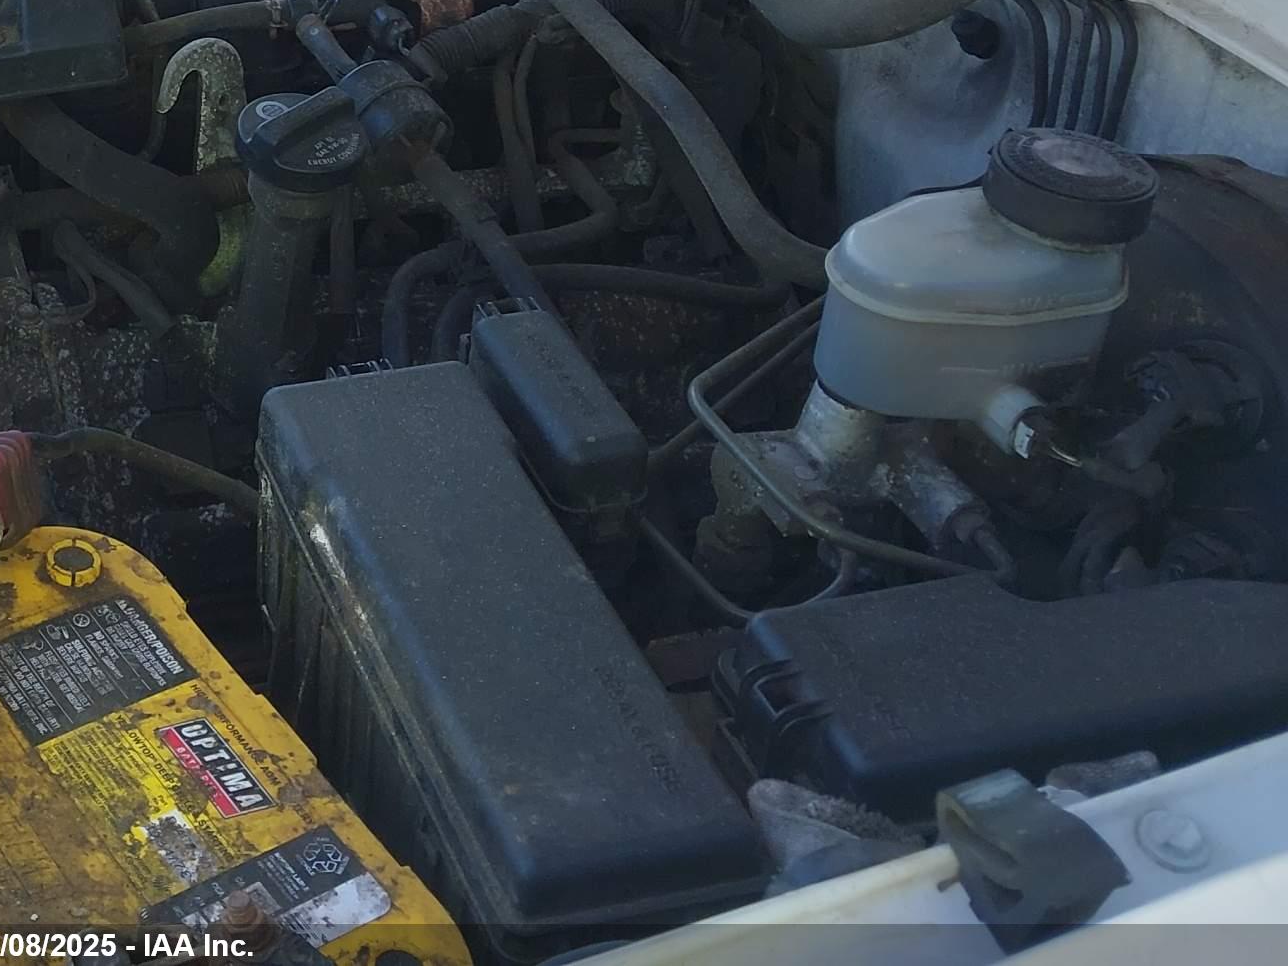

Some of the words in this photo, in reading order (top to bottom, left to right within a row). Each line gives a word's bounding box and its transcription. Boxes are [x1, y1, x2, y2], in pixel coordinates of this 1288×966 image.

[154, 762, 175, 785] DEEP
[181, 723, 264, 808] OPTIMA
[259, 763, 281, 786] AGM
